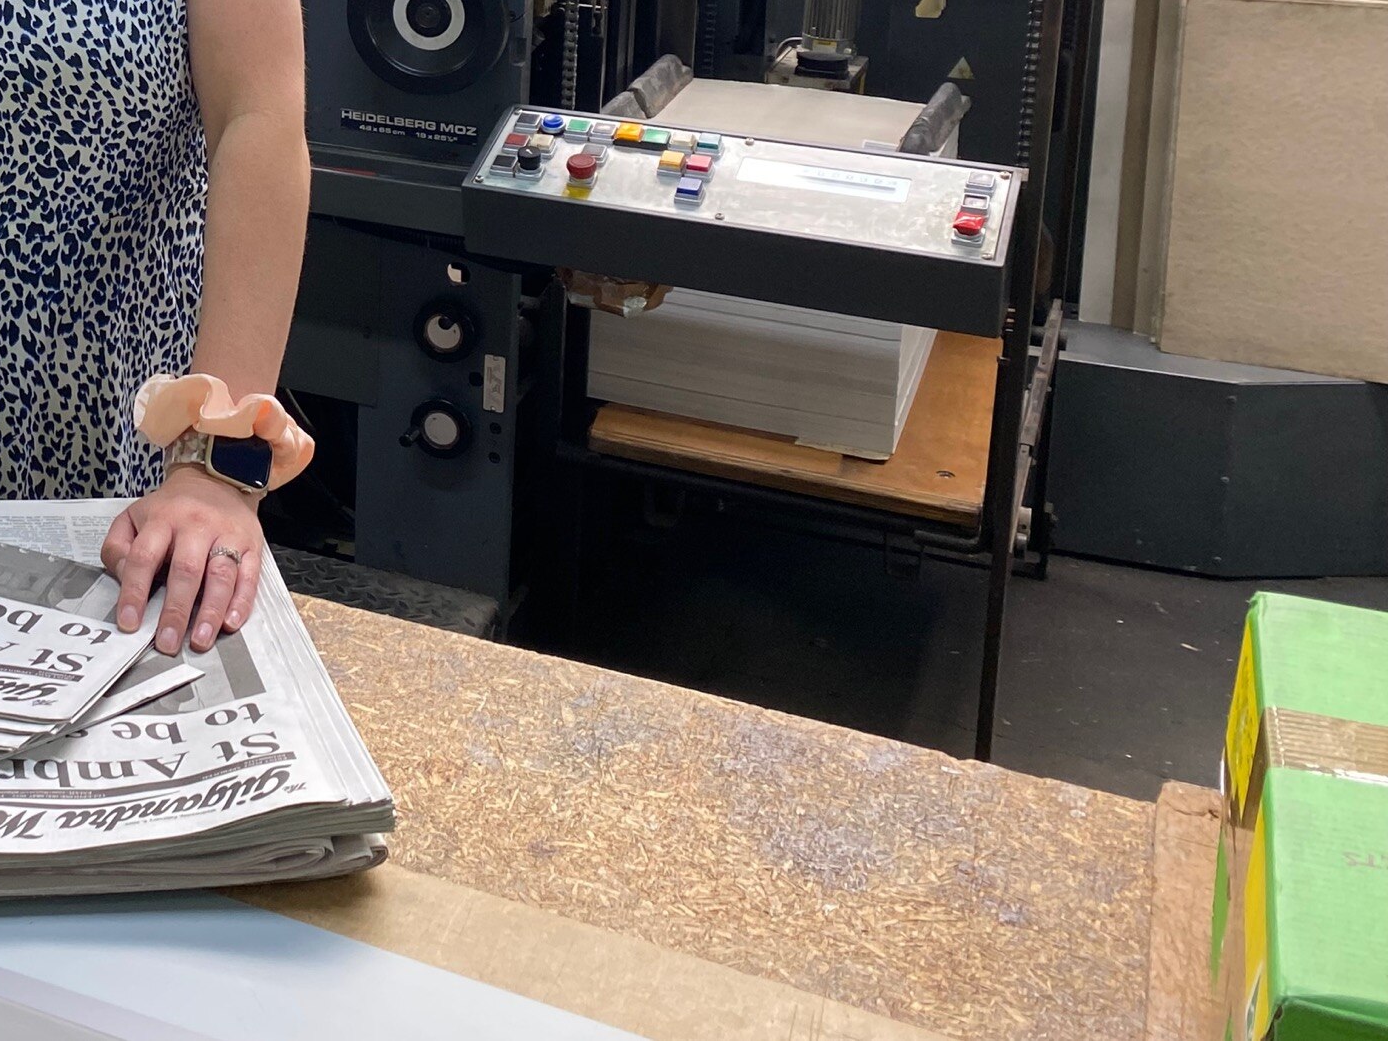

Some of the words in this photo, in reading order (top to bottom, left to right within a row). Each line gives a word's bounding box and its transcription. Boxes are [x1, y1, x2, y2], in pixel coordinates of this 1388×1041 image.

[341, 109, 437, 131] HEIDELBERG
[440, 122, 477, 136] MOZ
[59, 621, 112, 646] to
[27, 648, 94, 674] St
[204, 702, 265, 728] to
[110, 720, 187, 746] be
[211, 731, 281, 763] St
[54, 764, 292, 832] Gilgandra
